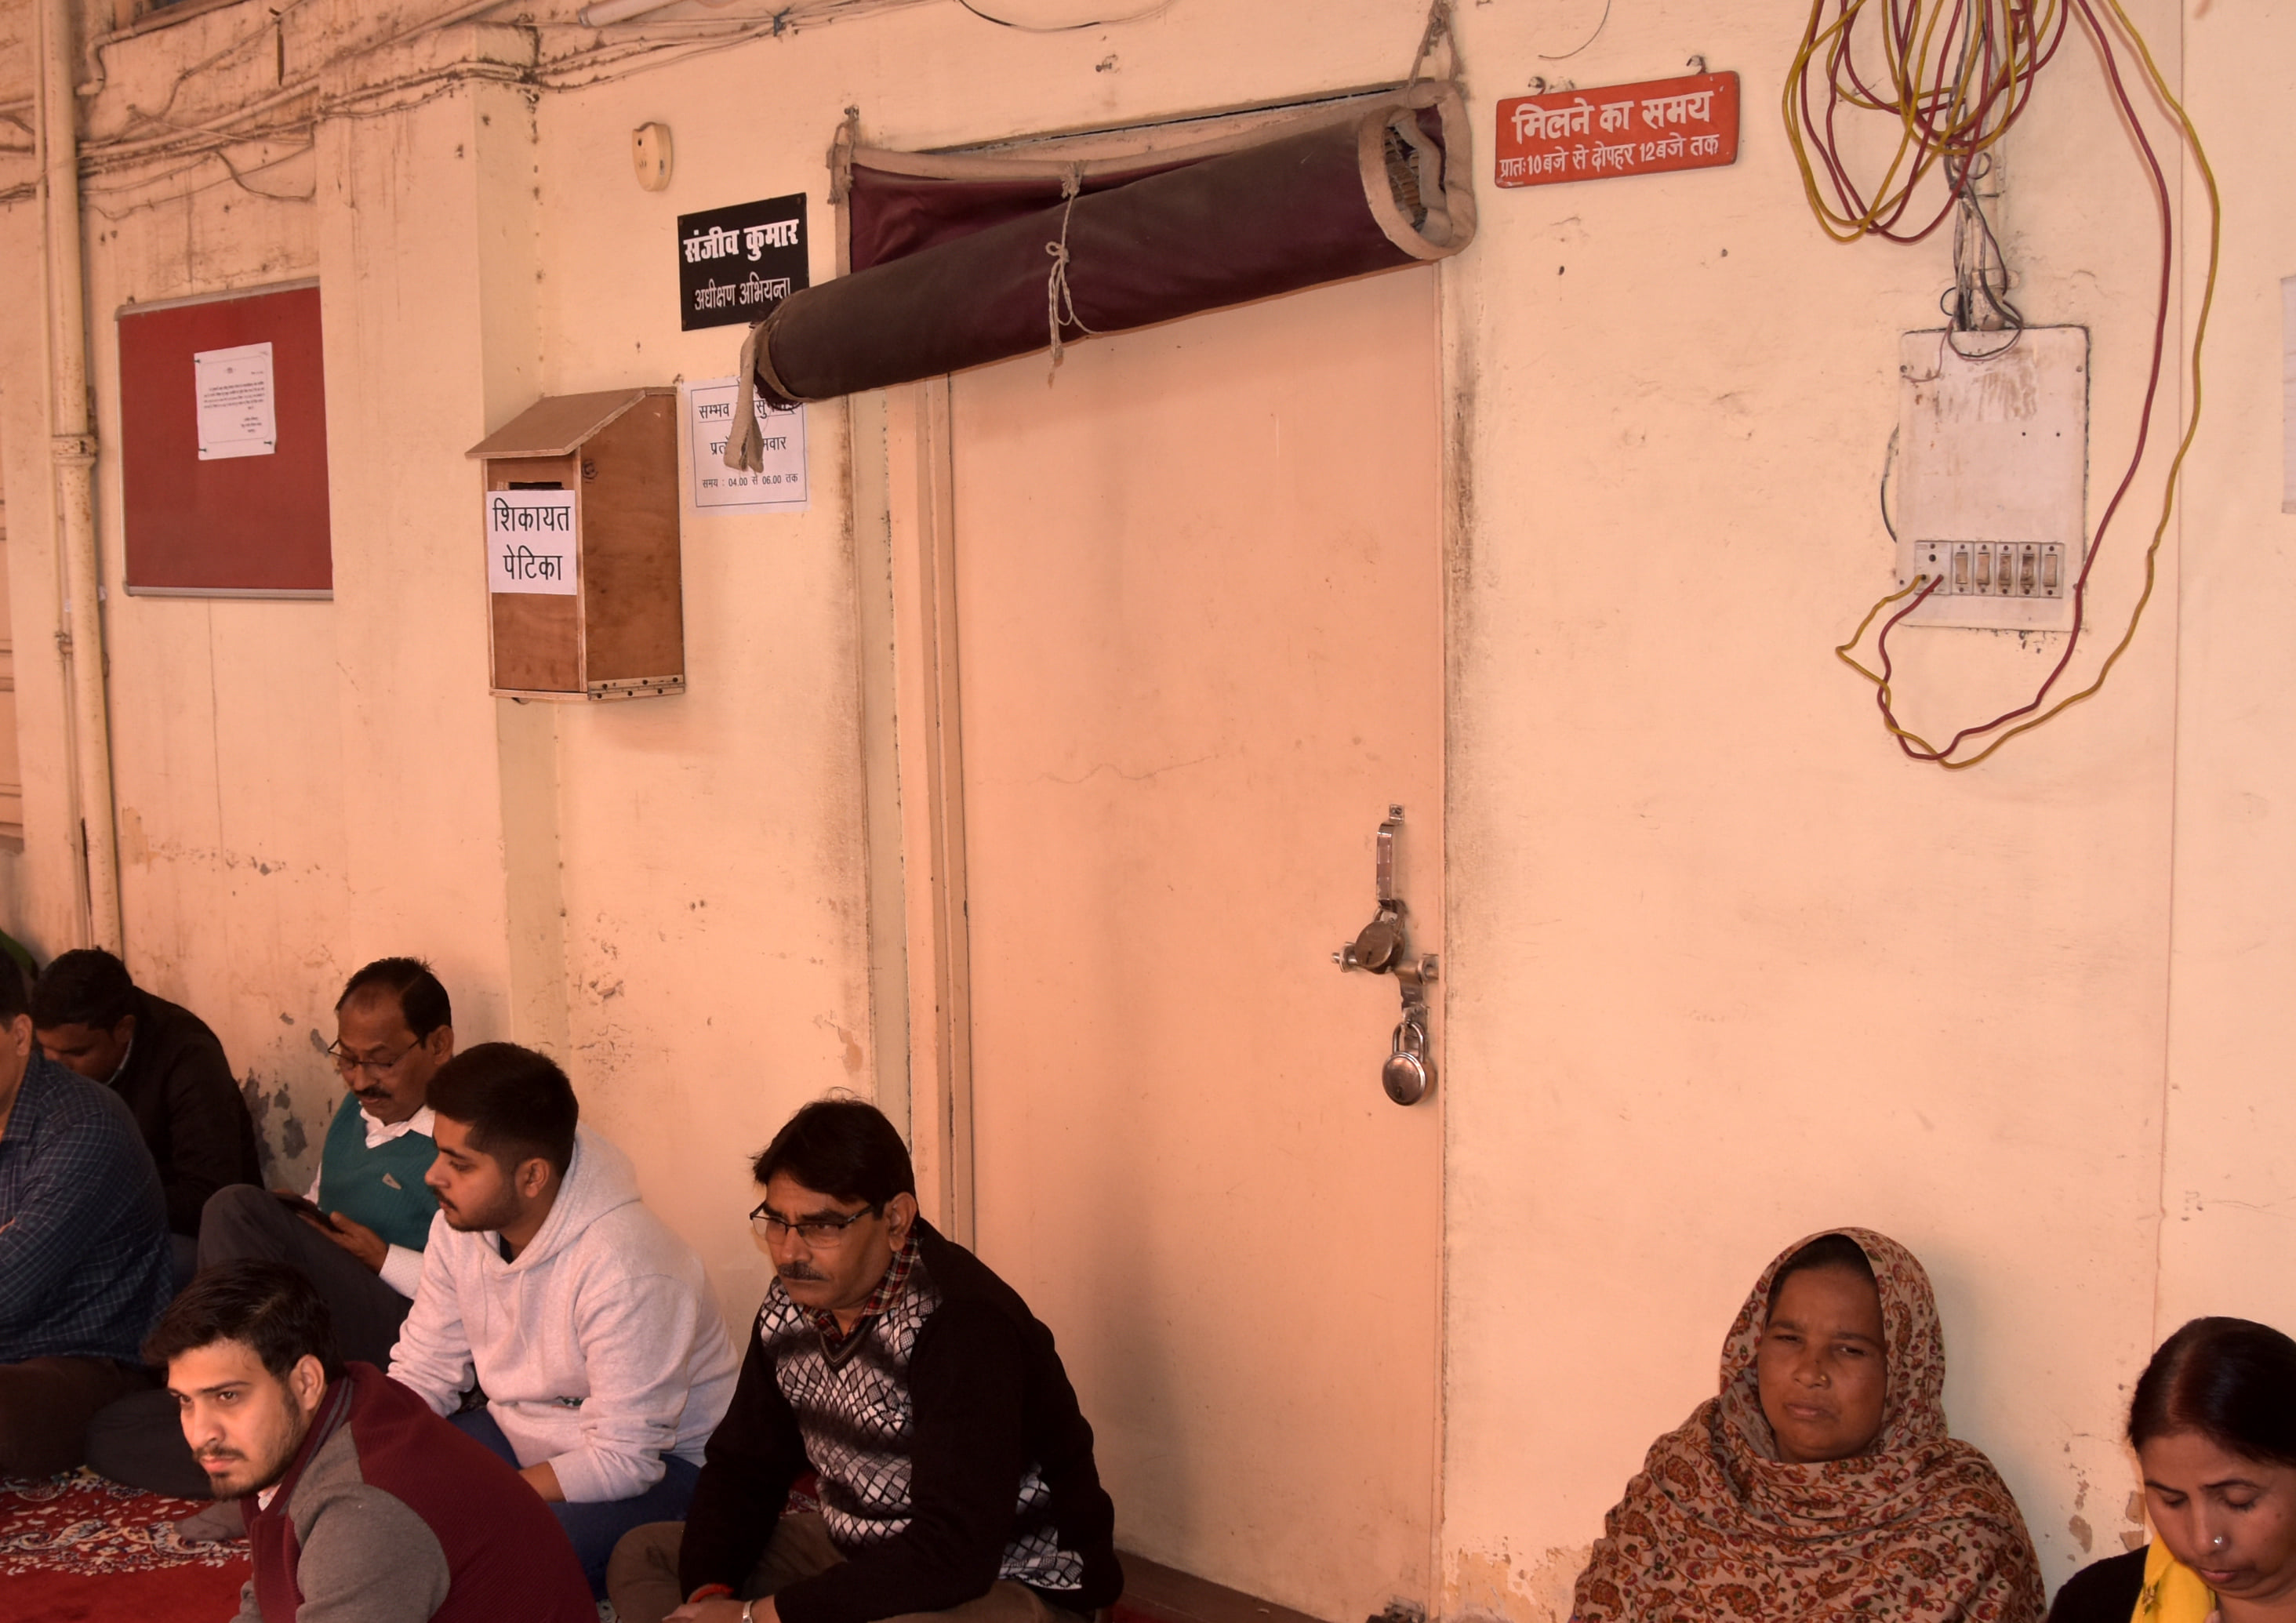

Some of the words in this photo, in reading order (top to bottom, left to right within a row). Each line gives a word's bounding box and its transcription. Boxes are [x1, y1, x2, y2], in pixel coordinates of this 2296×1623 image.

[1511, 97, 1595, 144] मिलने
[1600, 100, 1634, 133] का
[1641, 90, 1714, 129] समय
[1572, 144, 1589, 169] से
[1592, 141, 1636, 172] दोपहर
[1691, 134, 1720, 155] तक
[683, 226, 739, 263] संजीव
[743, 219, 799, 261] कुमार
[695, 278, 736, 310] अधीक्षण
[739, 271, 790, 305] अभियन्ता
[698, 403, 729, 419] सम्भव
[703, 479, 718, 488] समय
[728, 477, 747, 487] 04.00
[762, 475, 781, 485] 06.00
[785, 473, 798, 482] तक
[492, 497, 571, 532] शिकायत
[503, 544, 563, 580] पेटिका
